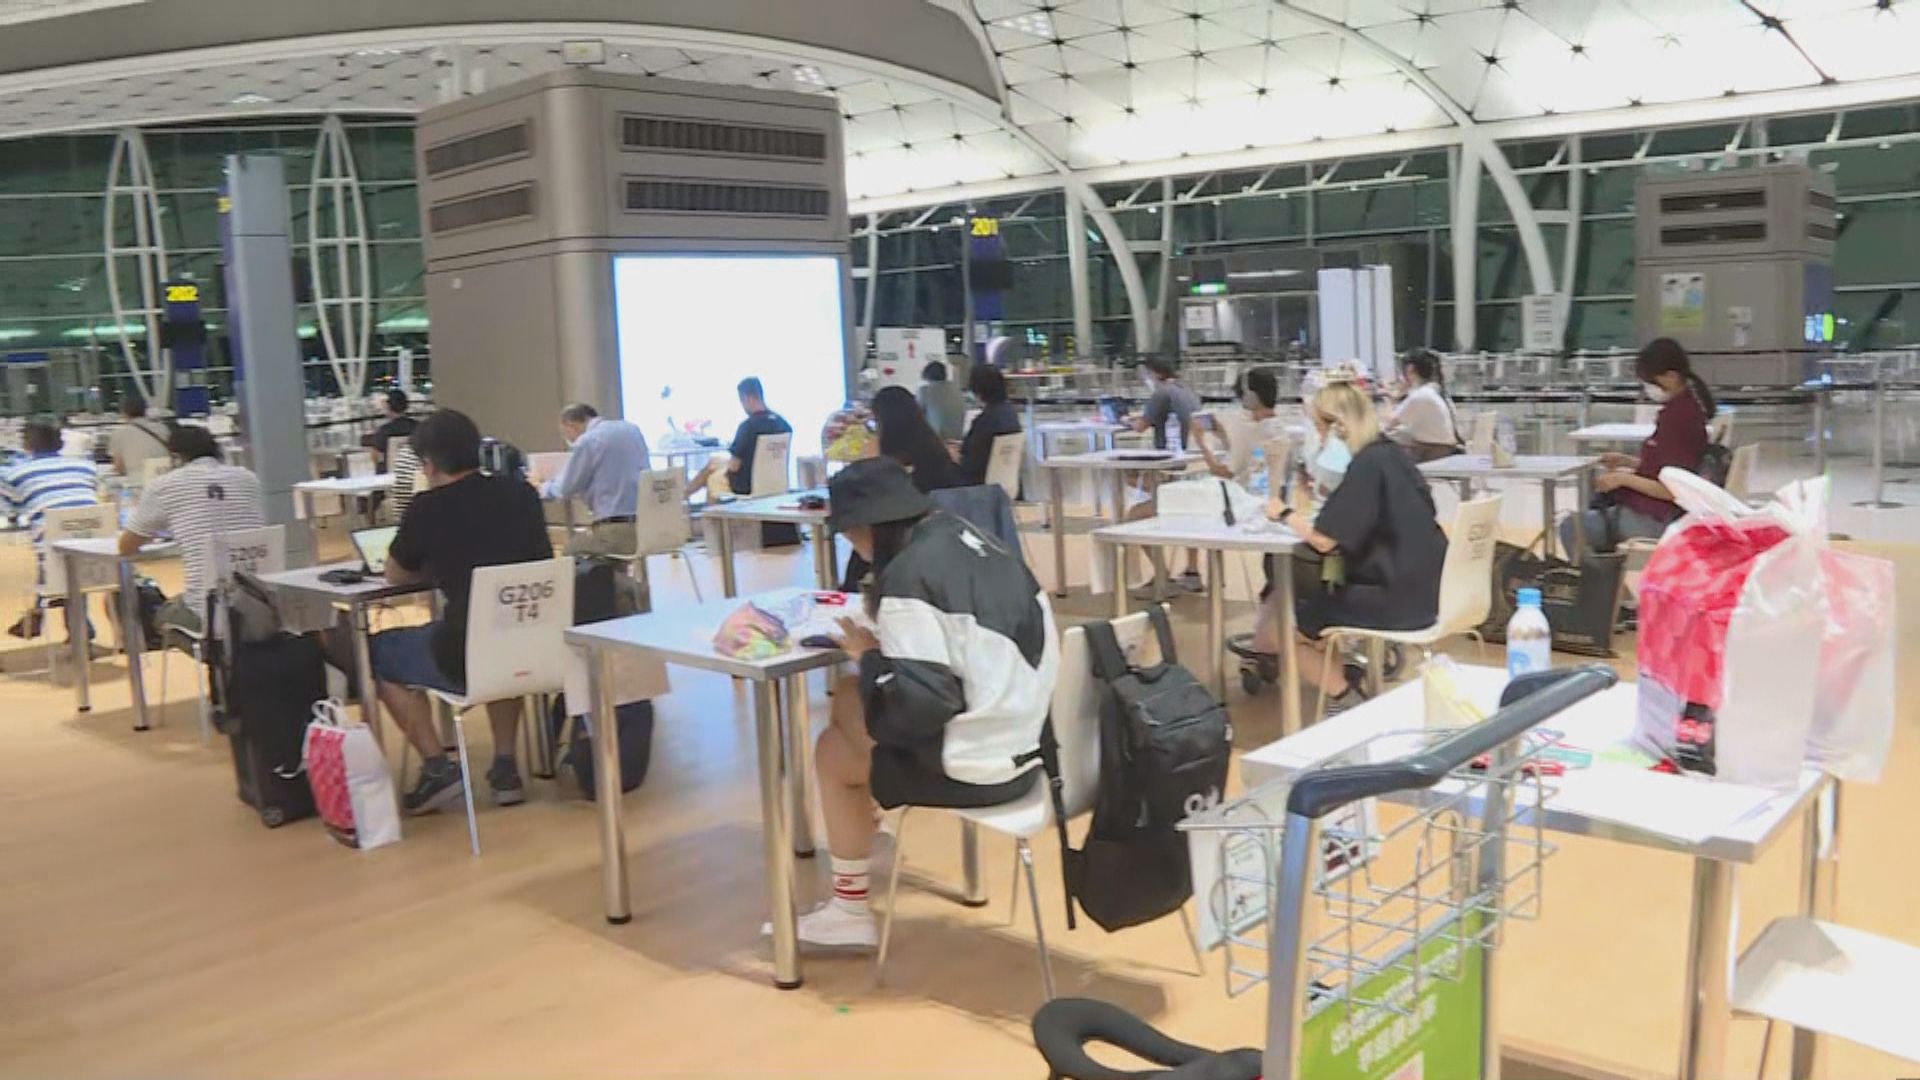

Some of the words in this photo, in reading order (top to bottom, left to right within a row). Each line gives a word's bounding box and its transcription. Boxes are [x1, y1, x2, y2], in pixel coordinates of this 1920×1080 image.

[970, 217, 999, 236] 201
[166, 285, 199, 302] 202
[498, 580, 555, 605] G206
[512, 603, 539, 622] T4
